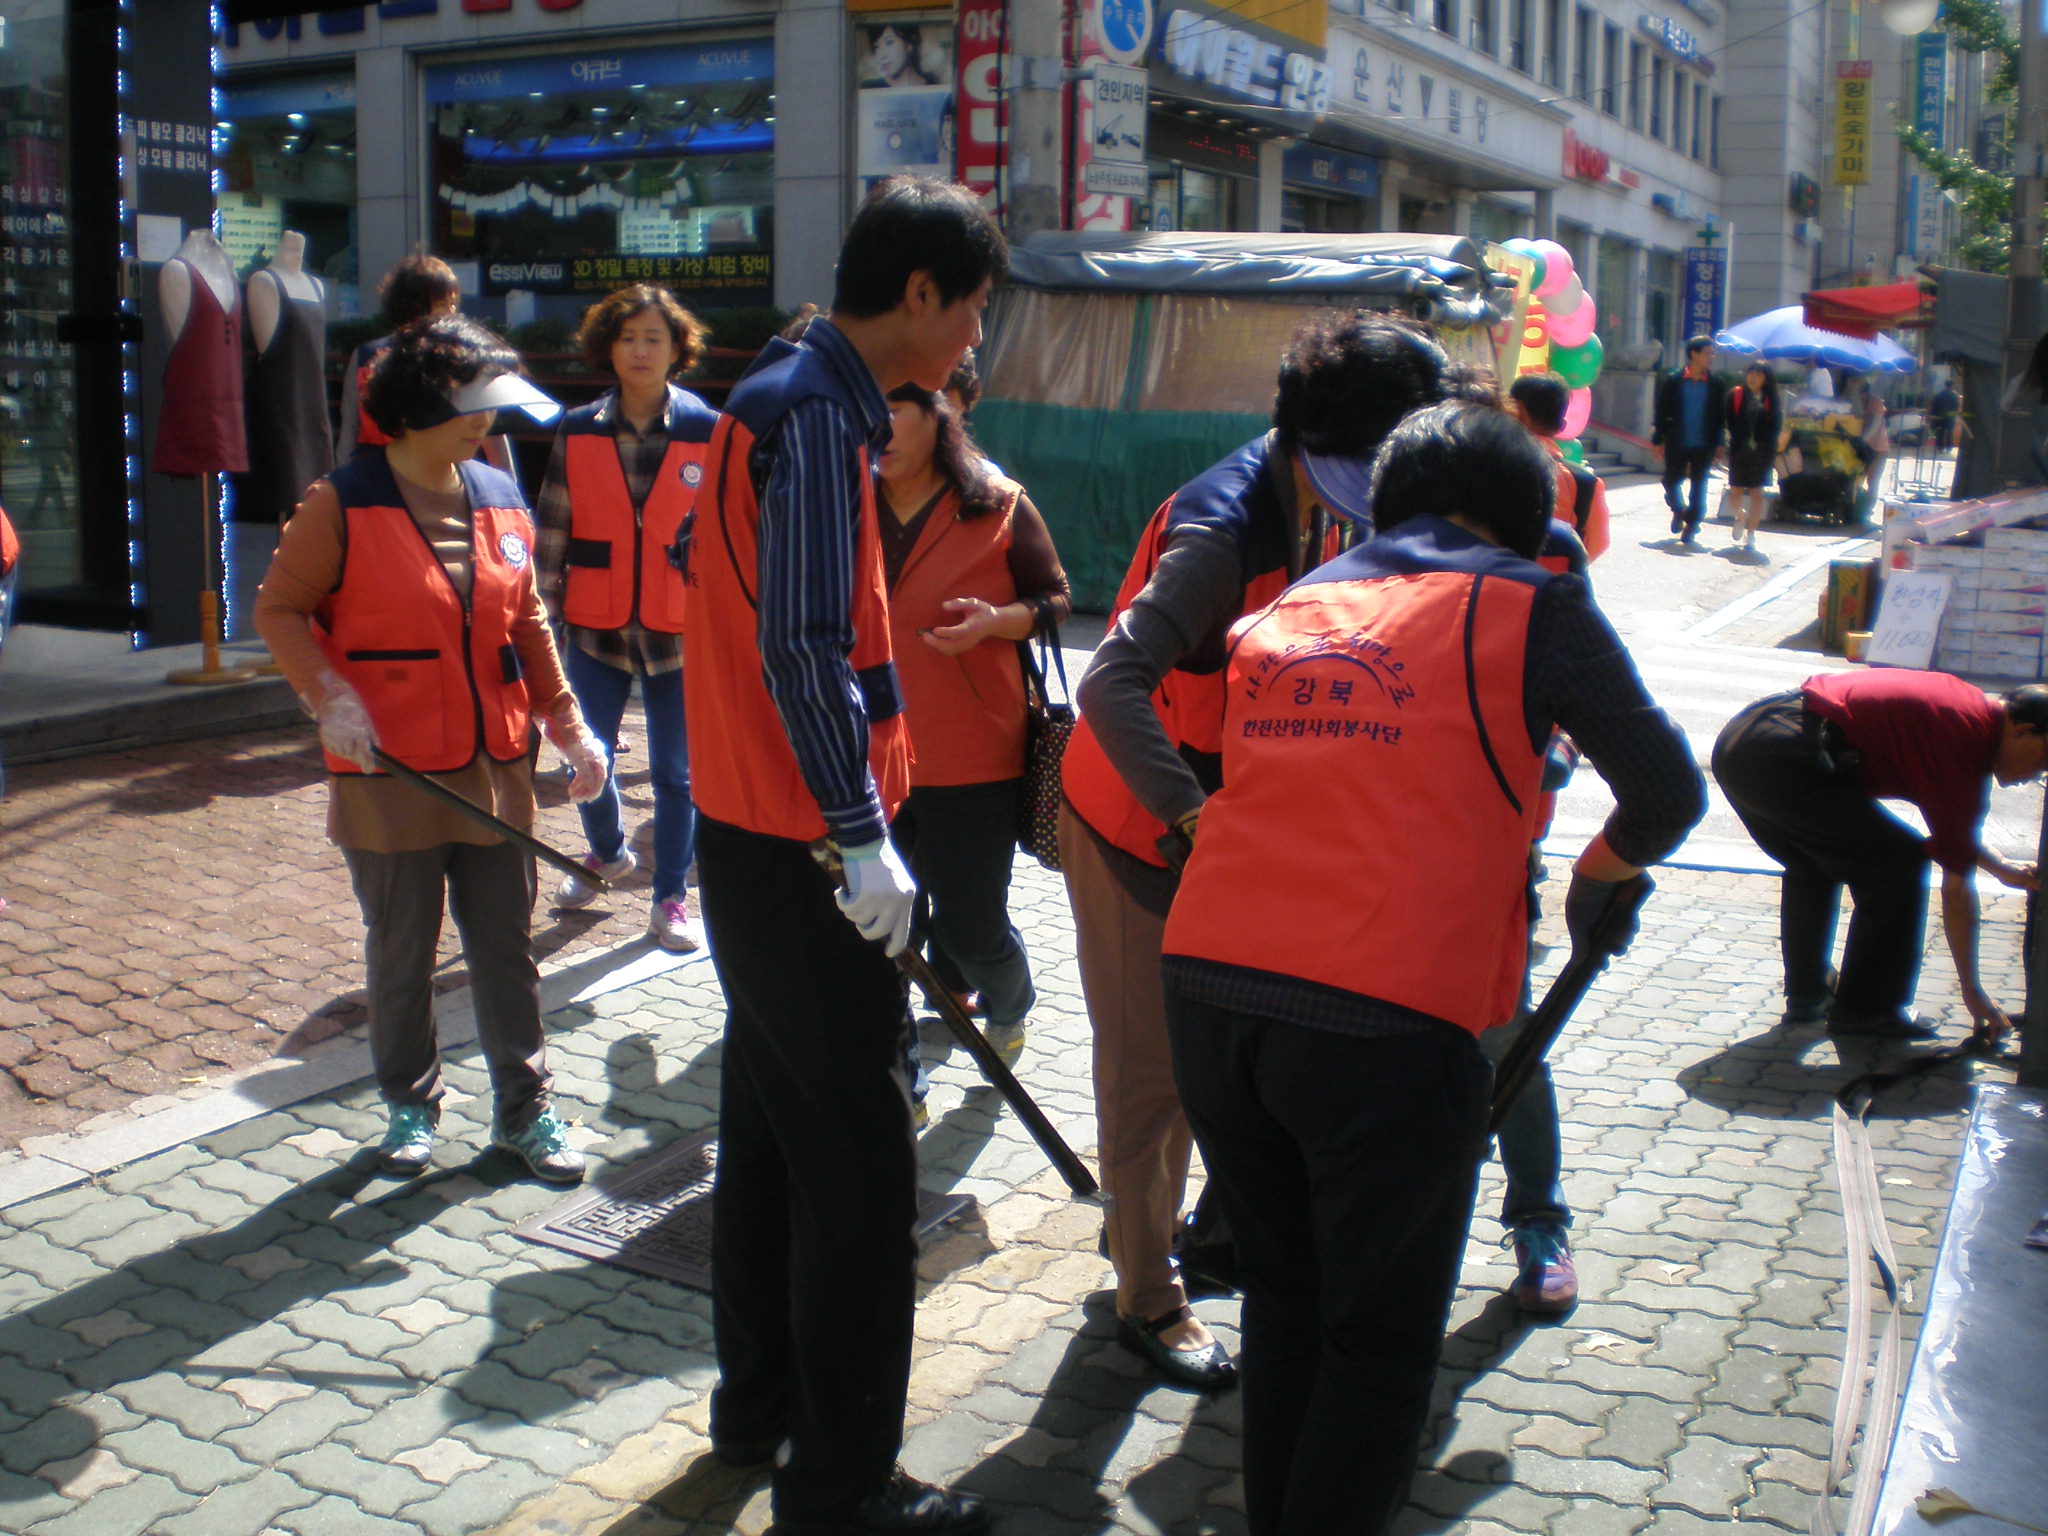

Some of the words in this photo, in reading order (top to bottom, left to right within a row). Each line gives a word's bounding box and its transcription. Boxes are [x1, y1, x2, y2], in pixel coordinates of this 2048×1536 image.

[697, 50, 751, 67] ACUVUE
[1098, 77, 1144, 105] 견인지역
[572, 260, 592, 278] 3D
[675, 256, 704, 276] 가상
[707, 255, 736, 275] 체험
